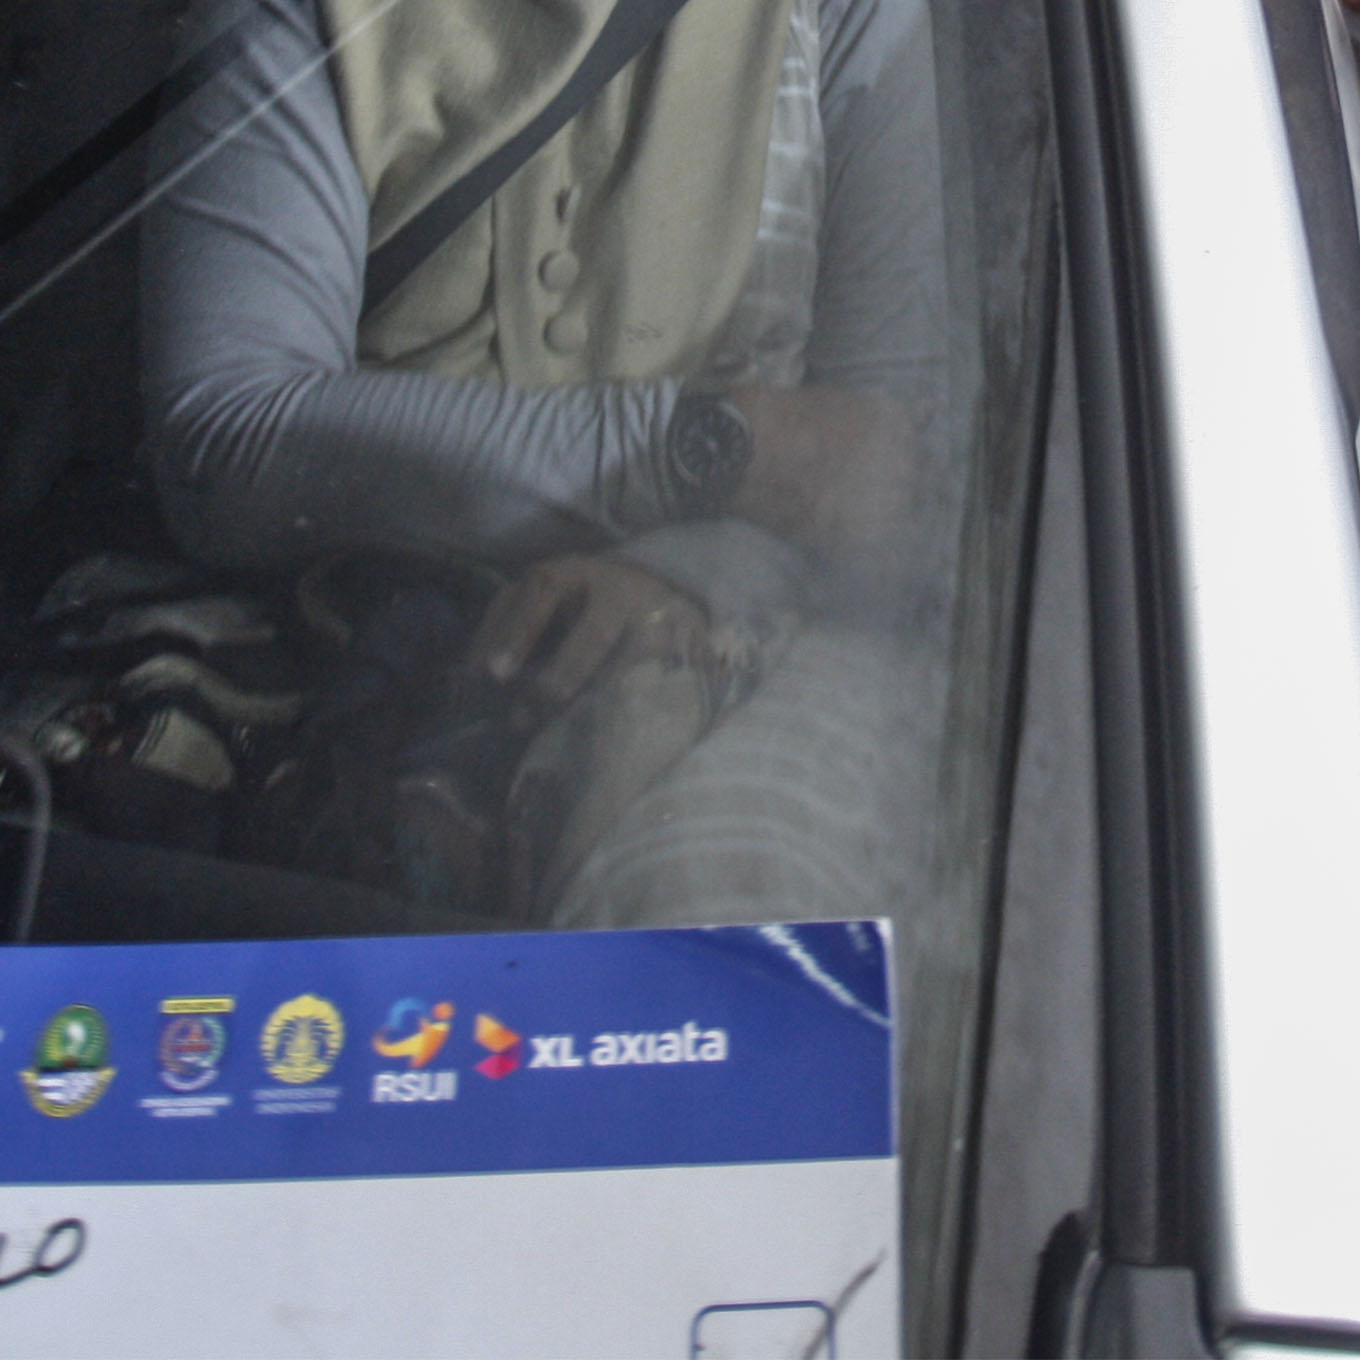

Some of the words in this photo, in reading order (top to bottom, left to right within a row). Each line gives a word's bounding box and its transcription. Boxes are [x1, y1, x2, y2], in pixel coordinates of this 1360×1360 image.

[529, 1036, 584, 1069] XL
[590, 1021, 728, 1067] axiata
[372, 1071, 457, 1103] RSUI
